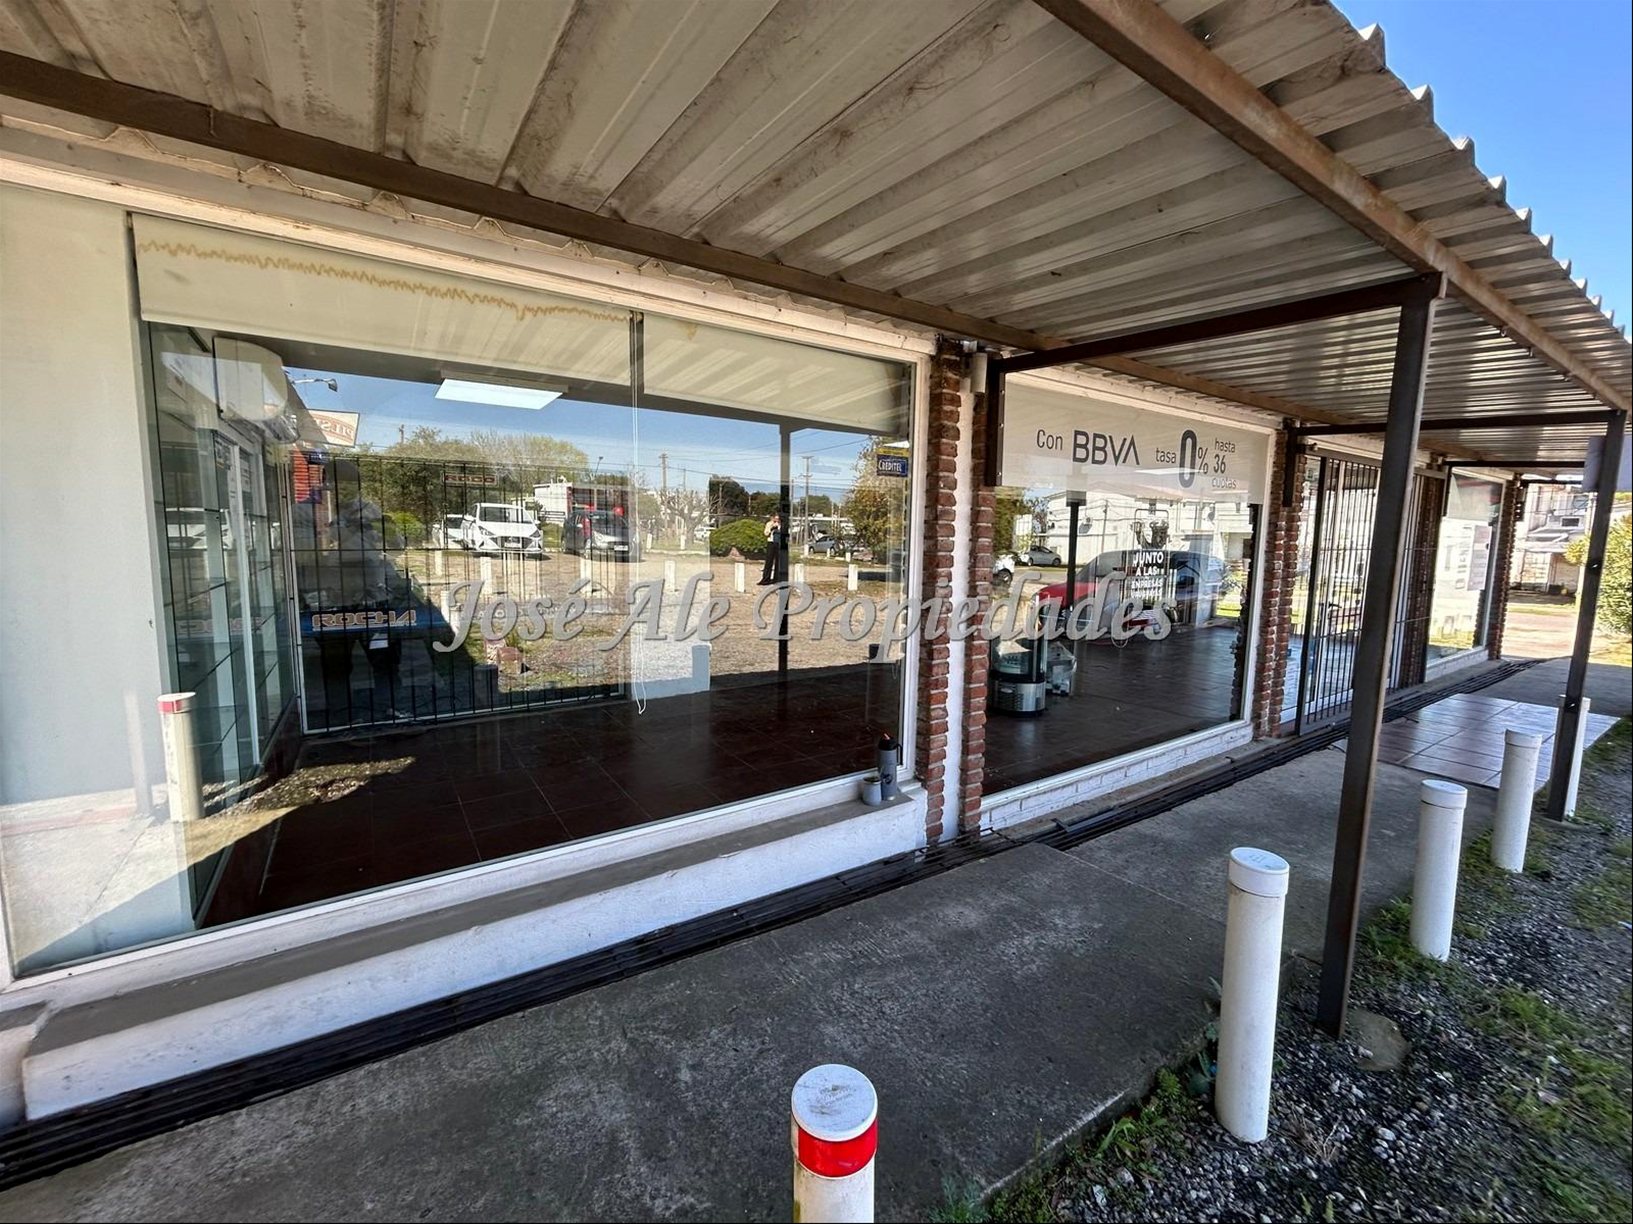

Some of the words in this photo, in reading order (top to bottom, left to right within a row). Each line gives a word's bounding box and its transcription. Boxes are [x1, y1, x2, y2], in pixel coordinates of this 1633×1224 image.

[1037, 429, 1063, 451] Con
[1072, 429, 1140, 466] BBVA
[1155, 447, 1177, 464] tasa
[1214, 438, 1236, 453] hasta
[1213, 454, 1226, 474] 36
[1211, 477, 1237, 490] cuotas
[1132, 551, 1164, 564] JUNTO
[1135, 567, 1141, 576] A
[1143, 566, 1158, 576] LAS
